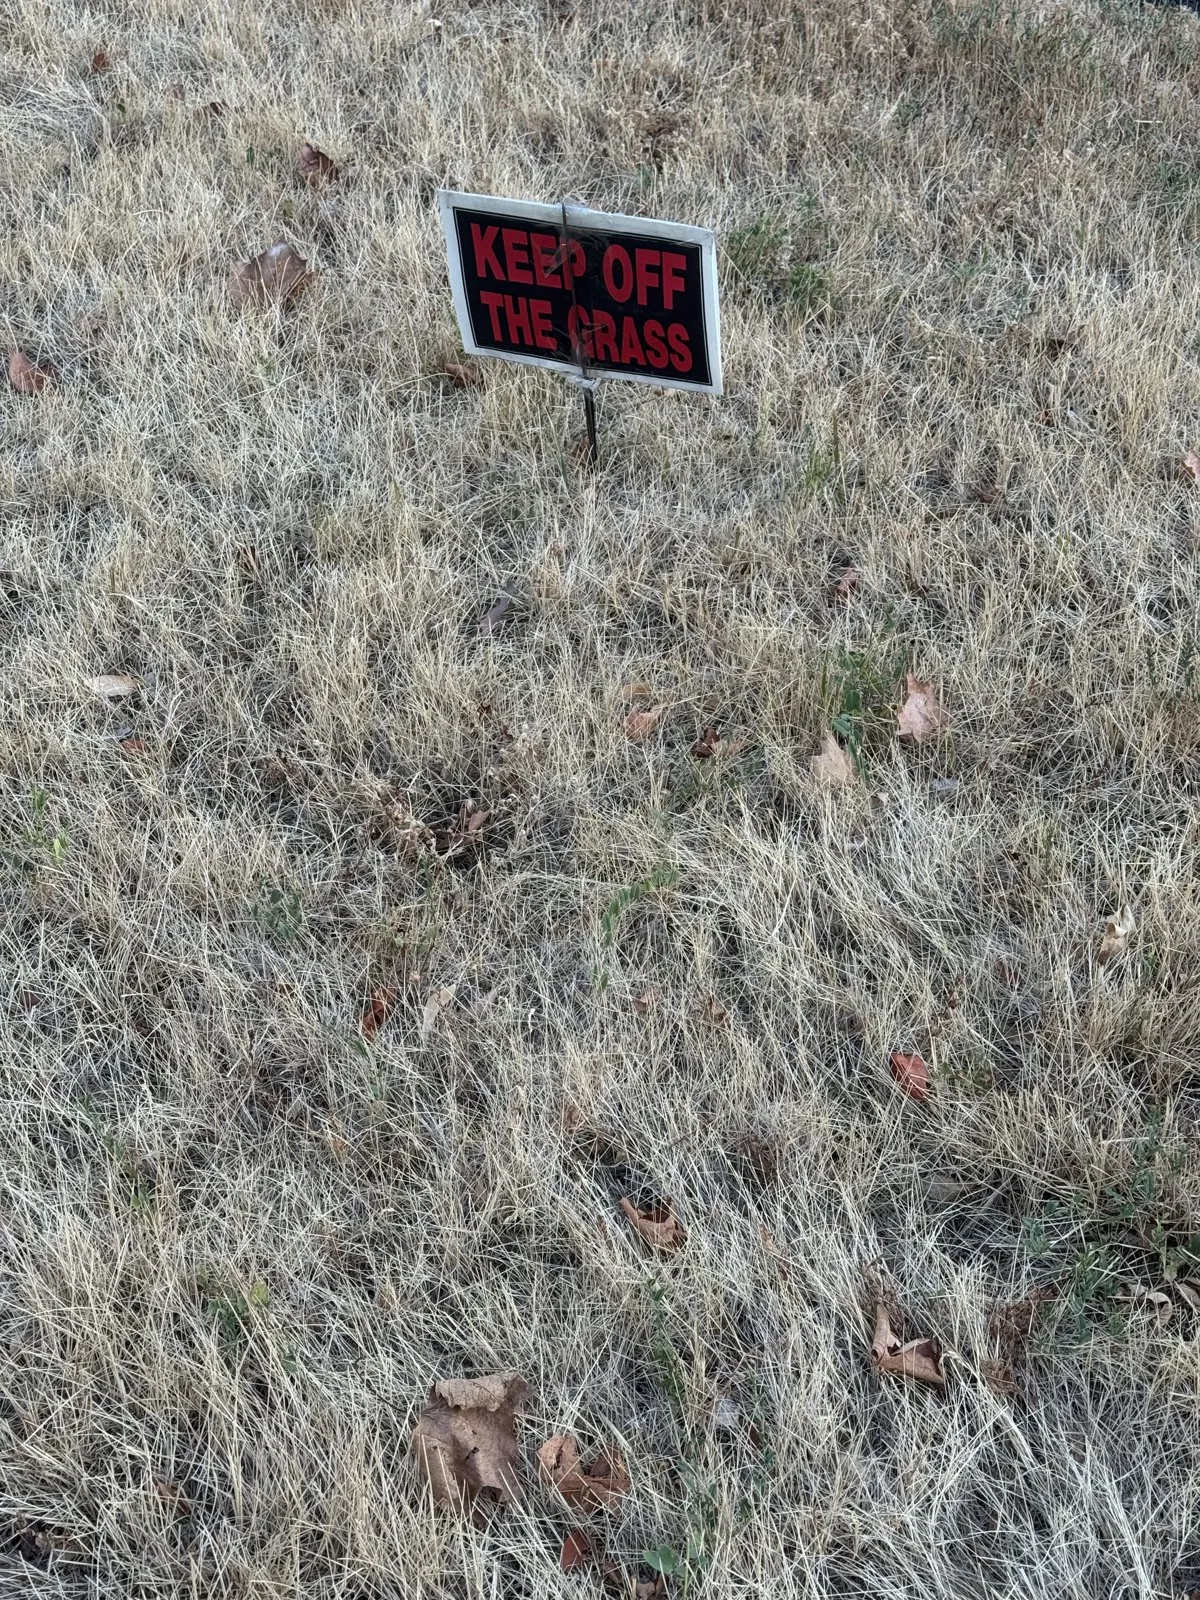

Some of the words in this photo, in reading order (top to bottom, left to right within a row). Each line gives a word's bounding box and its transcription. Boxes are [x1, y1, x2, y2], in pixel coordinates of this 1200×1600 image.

[470, 223, 586, 290] KEEP
[602, 243, 687, 310] OFF
[480, 291, 558, 351] THE
[567, 304, 692, 372] GRASS
